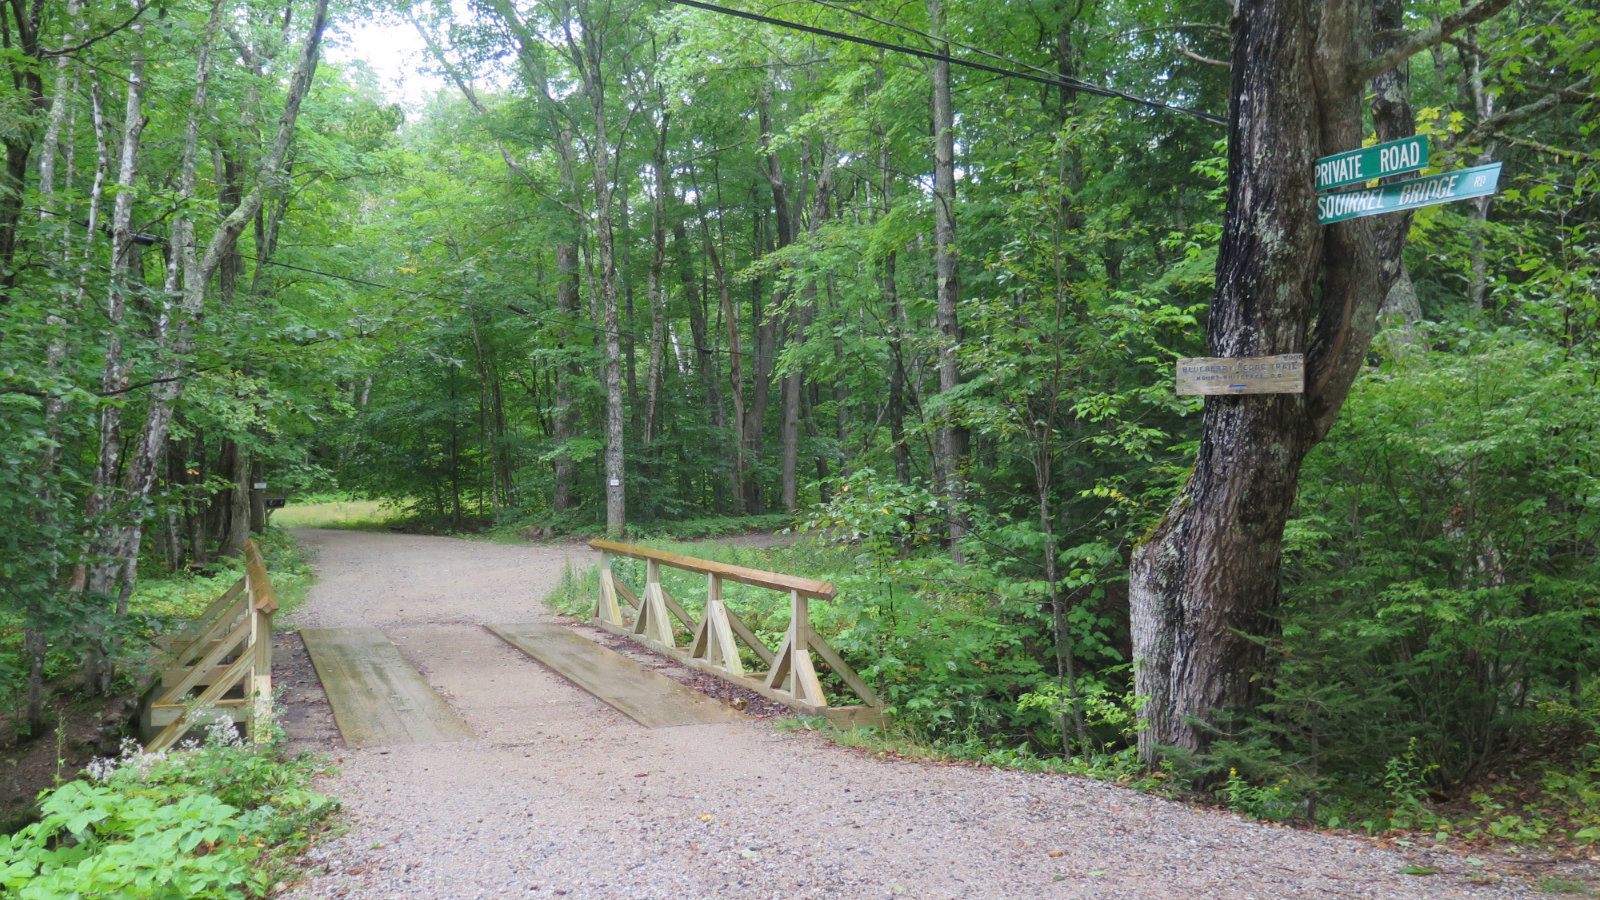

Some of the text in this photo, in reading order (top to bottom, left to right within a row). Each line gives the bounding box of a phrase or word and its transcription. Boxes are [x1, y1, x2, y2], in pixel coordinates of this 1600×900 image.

[1314, 141, 1420, 187] PRIVATE ROAD
[1317, 175, 1487, 220] SQUIRREL BRIDGE RD
[1182, 365, 1234, 374] BLUEBERRY
[1271, 362, 1297, 370] TRAIL
